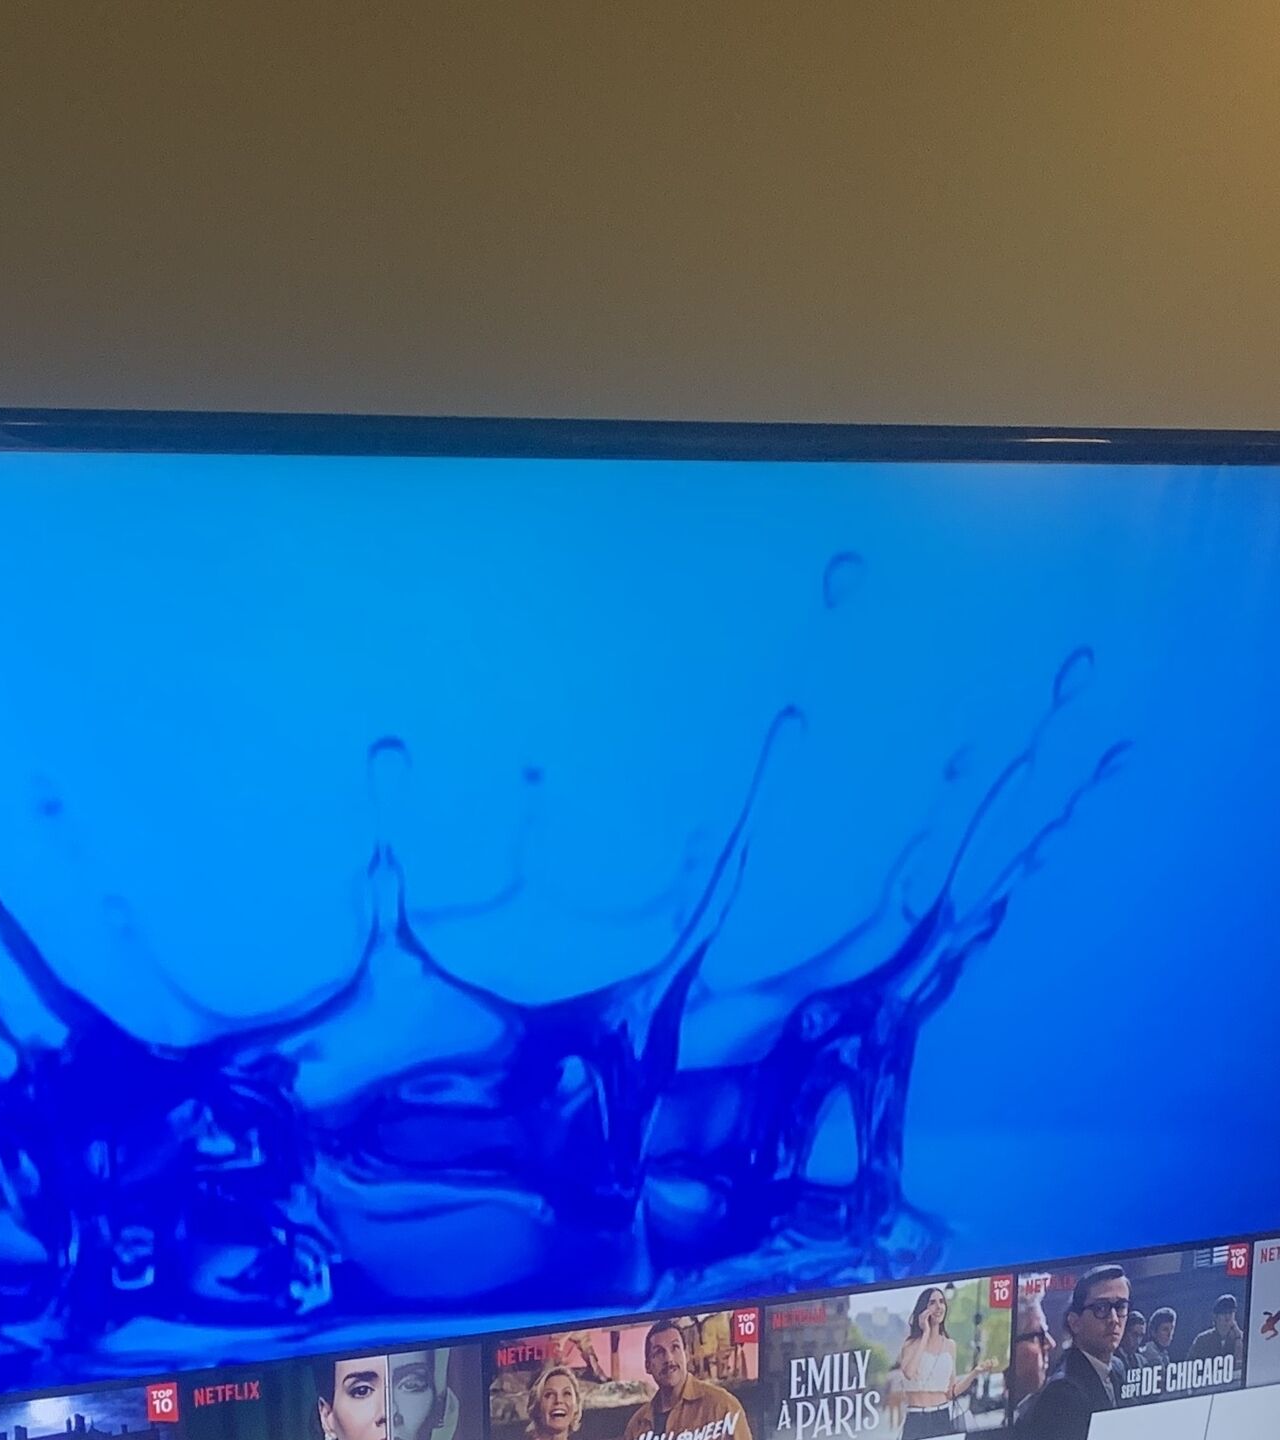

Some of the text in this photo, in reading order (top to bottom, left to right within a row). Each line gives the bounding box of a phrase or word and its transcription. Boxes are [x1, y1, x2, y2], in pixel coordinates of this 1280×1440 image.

[1231, 1248, 1248, 1258] TOP
[1231, 1257, 1247, 1270] 10
[994, 1280, 1010, 1290] TOP
[994, 1288, 1010, 1301] 10
[737, 1313, 755, 1324] TOP
[738, 1322, 755, 1336] 10
[789, 1349, 871, 1400] EMILY
[1127, 1368, 1141, 1383] LES
[1141, 1354, 1234, 1396] DE CHICAGO
[151, 1389, 173, 1400] TOP
[194, 1380, 260, 1408] NETFLIX
[1121, 1382, 1140, 1399] SEPT
[152, 1399, 173, 1414] 10
[777, 1391, 881, 1440] À PARIS
